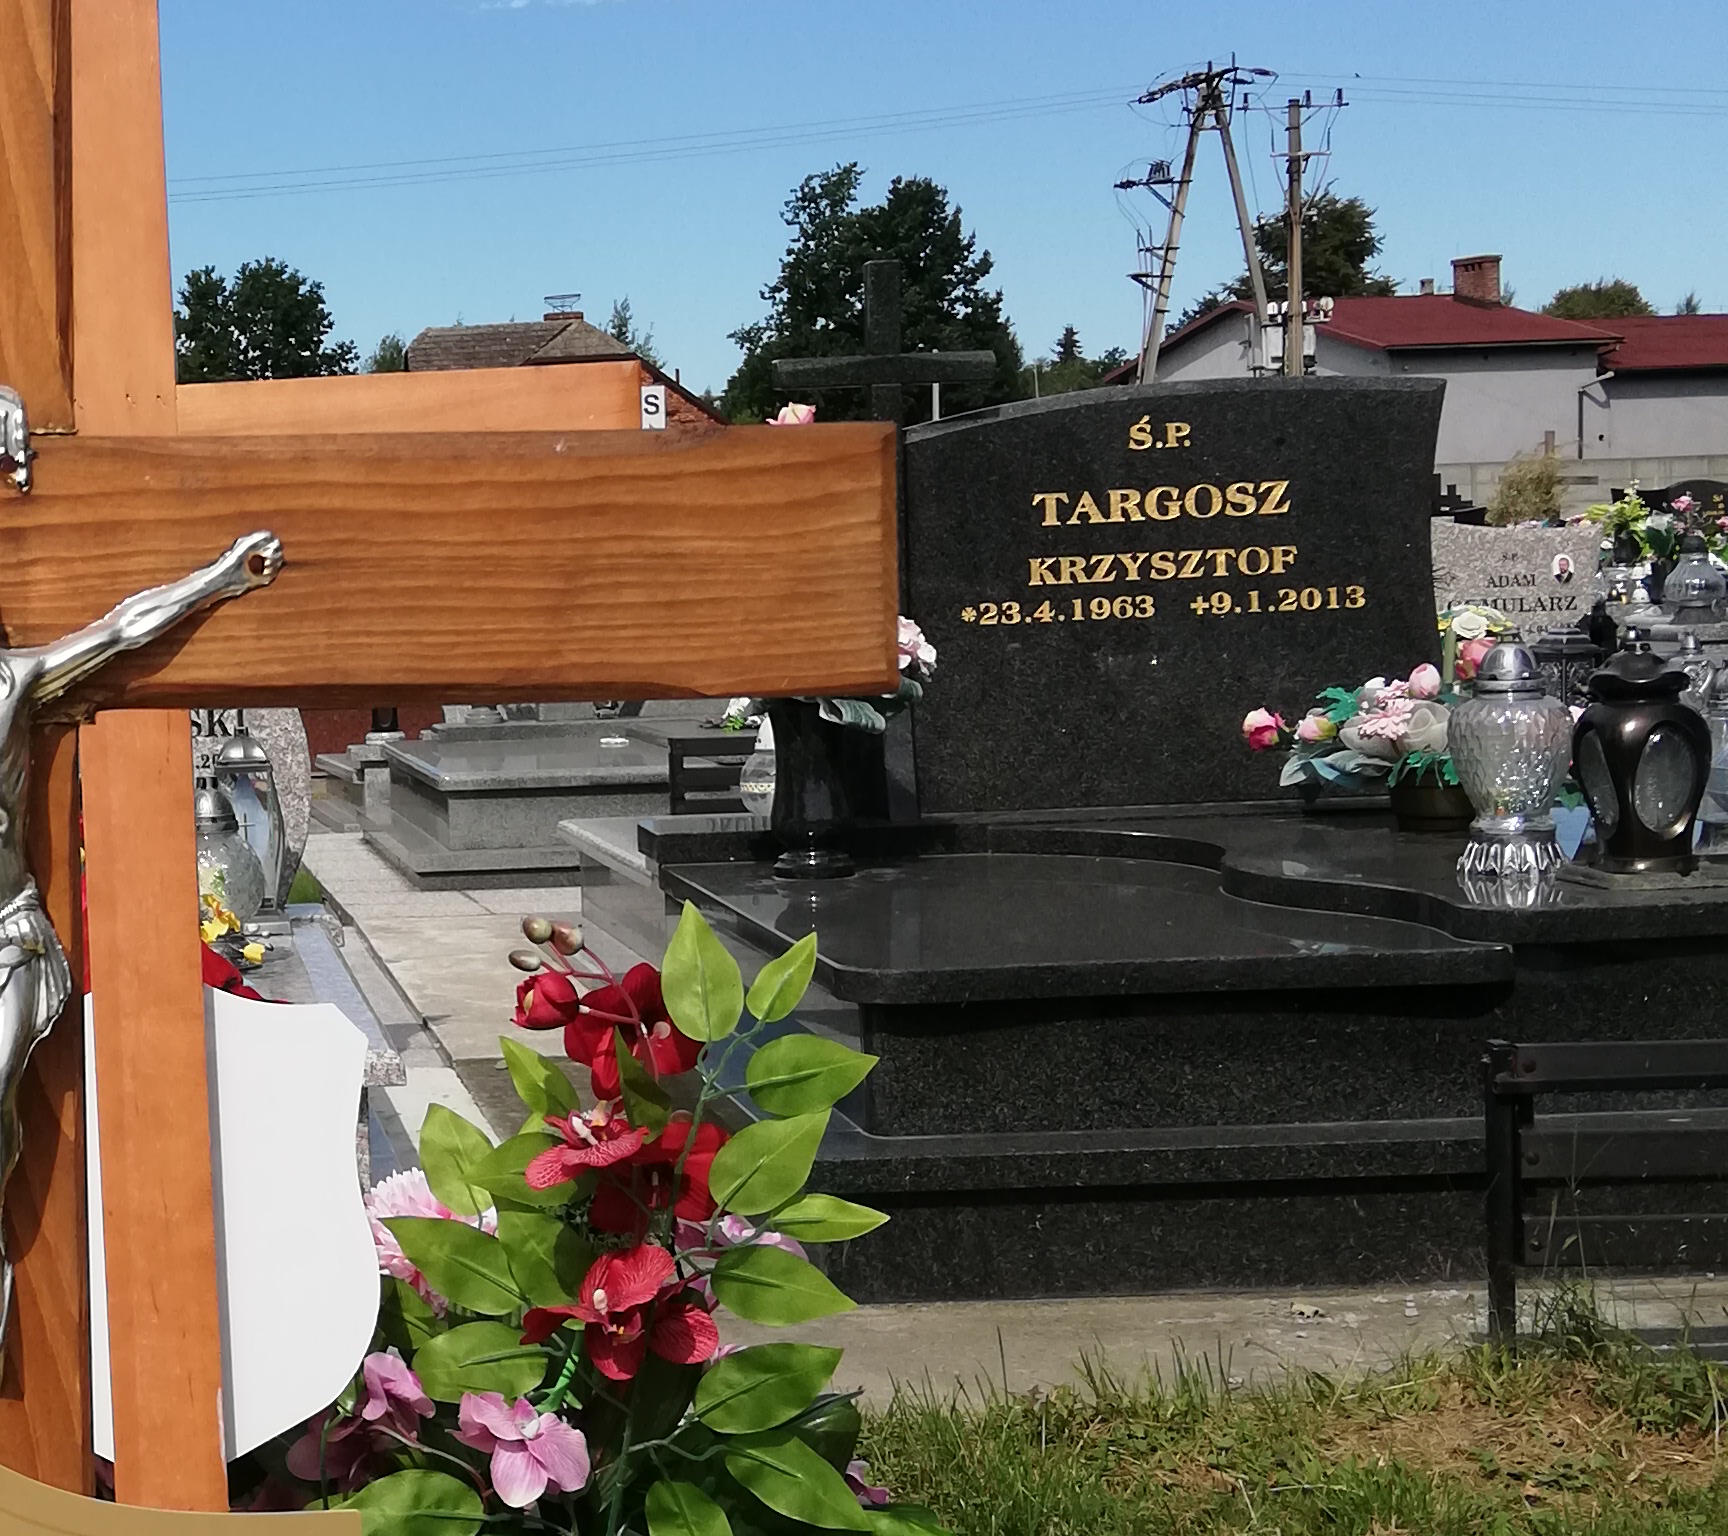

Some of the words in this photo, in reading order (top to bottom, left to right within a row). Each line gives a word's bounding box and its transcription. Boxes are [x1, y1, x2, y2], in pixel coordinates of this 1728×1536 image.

[1031, 479, 1291, 528] TARGOSZ
[1027, 544, 1299, 587] KRZYSZTOF
[1485, 573, 1538, 589] ADAM
